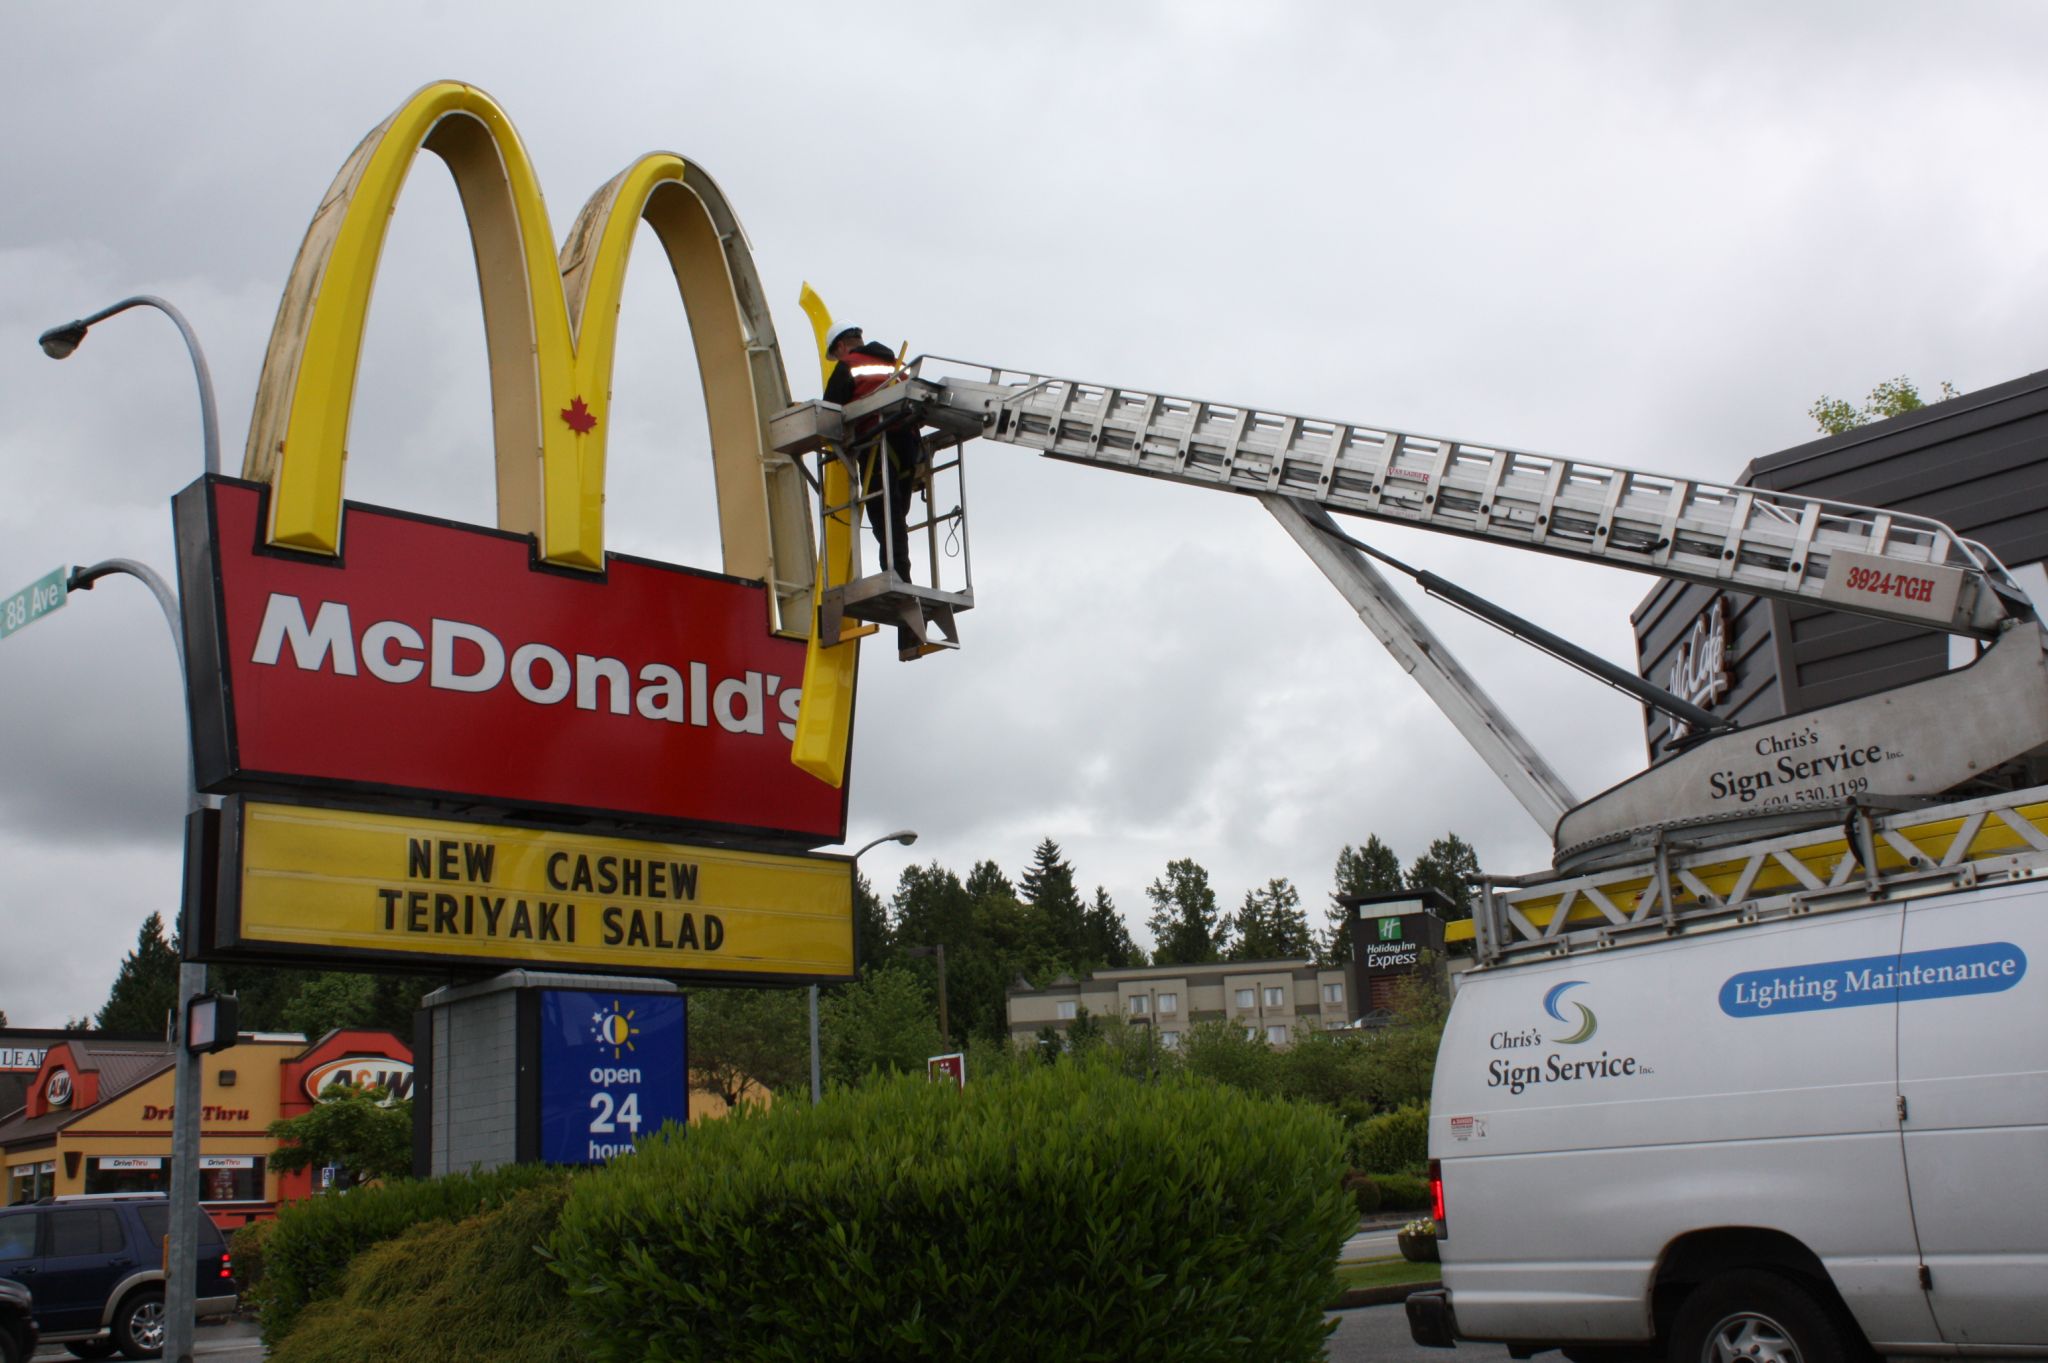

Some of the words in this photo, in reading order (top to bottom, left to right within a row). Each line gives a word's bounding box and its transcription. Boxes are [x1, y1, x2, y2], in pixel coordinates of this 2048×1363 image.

[1846, 566, 1936, 603] 3924-TGH
[7, 596, 26, 630] 88
[31, 583, 58, 617] Ave
[250, 592, 803, 743] McDonald's
[1756, 727, 1819, 756] Chris's
[1710, 770, 1774, 803] Sign
[1776, 743, 1882, 784] Service
[408, 838, 496, 883] NEW
[546, 852, 699, 901] CASHEW
[378, 889, 576, 943] TERIYAKI
[602, 907, 725, 952] SALAD
[1367, 943, 1401, 954] Holiday
[1401, 941, 1416, 951] Inn
[1367, 953, 1417, 969] Express
[1735, 976, 1838, 1009] Lighting
[1845, 957, 2017, 993] Maintenance
[1490, 1028, 1542, 1050] Chris's
[589, 1067, 641, 1088] open
[1487, 1059, 1541, 1095] Sign
[1545, 1050, 1636, 1083] Service
[1639, 1065, 1655, 1075] Inc.
[589, 1091, 642, 1133] 24
[589, 1140, 637, 1160] hour
